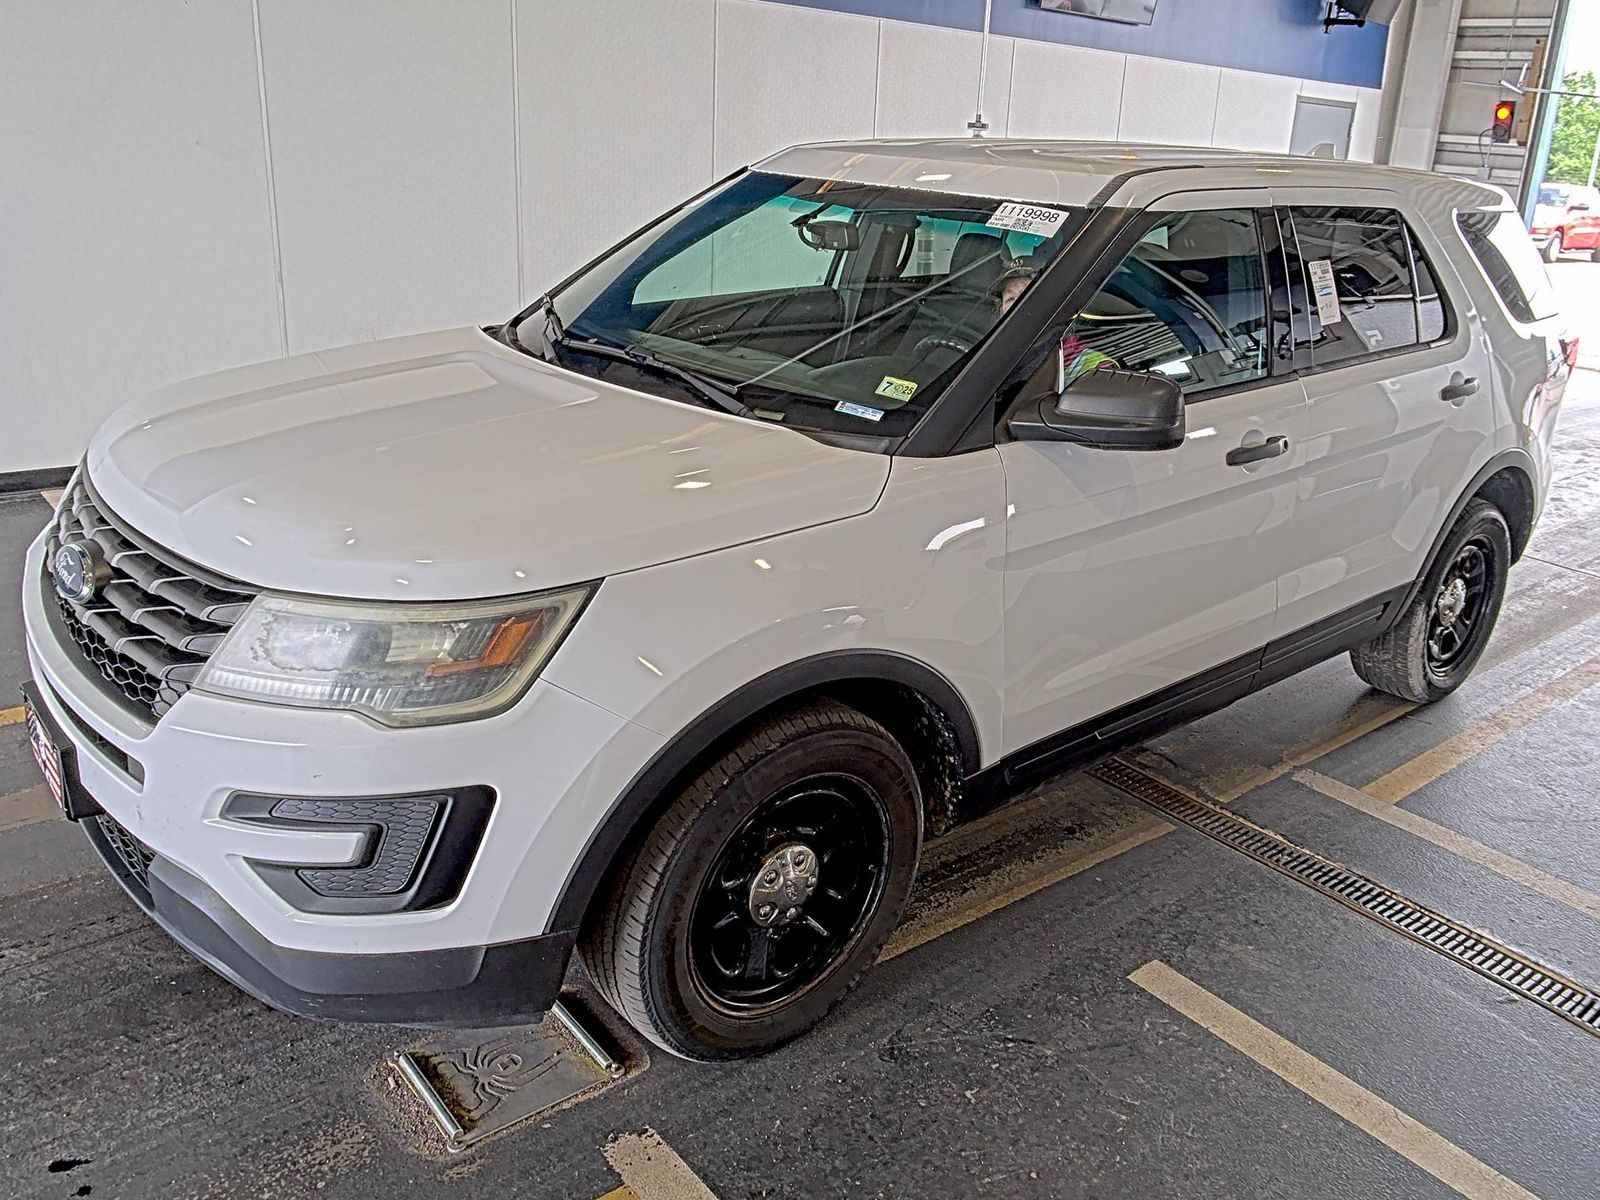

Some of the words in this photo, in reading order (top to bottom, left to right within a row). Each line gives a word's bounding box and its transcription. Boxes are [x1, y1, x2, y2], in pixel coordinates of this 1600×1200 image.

[1000, 204, 1060, 223] 1119998
[882, 381, 893, 392] 7
[903, 385, 914, 395] 25
[57, 552, 76, 585] Ford
